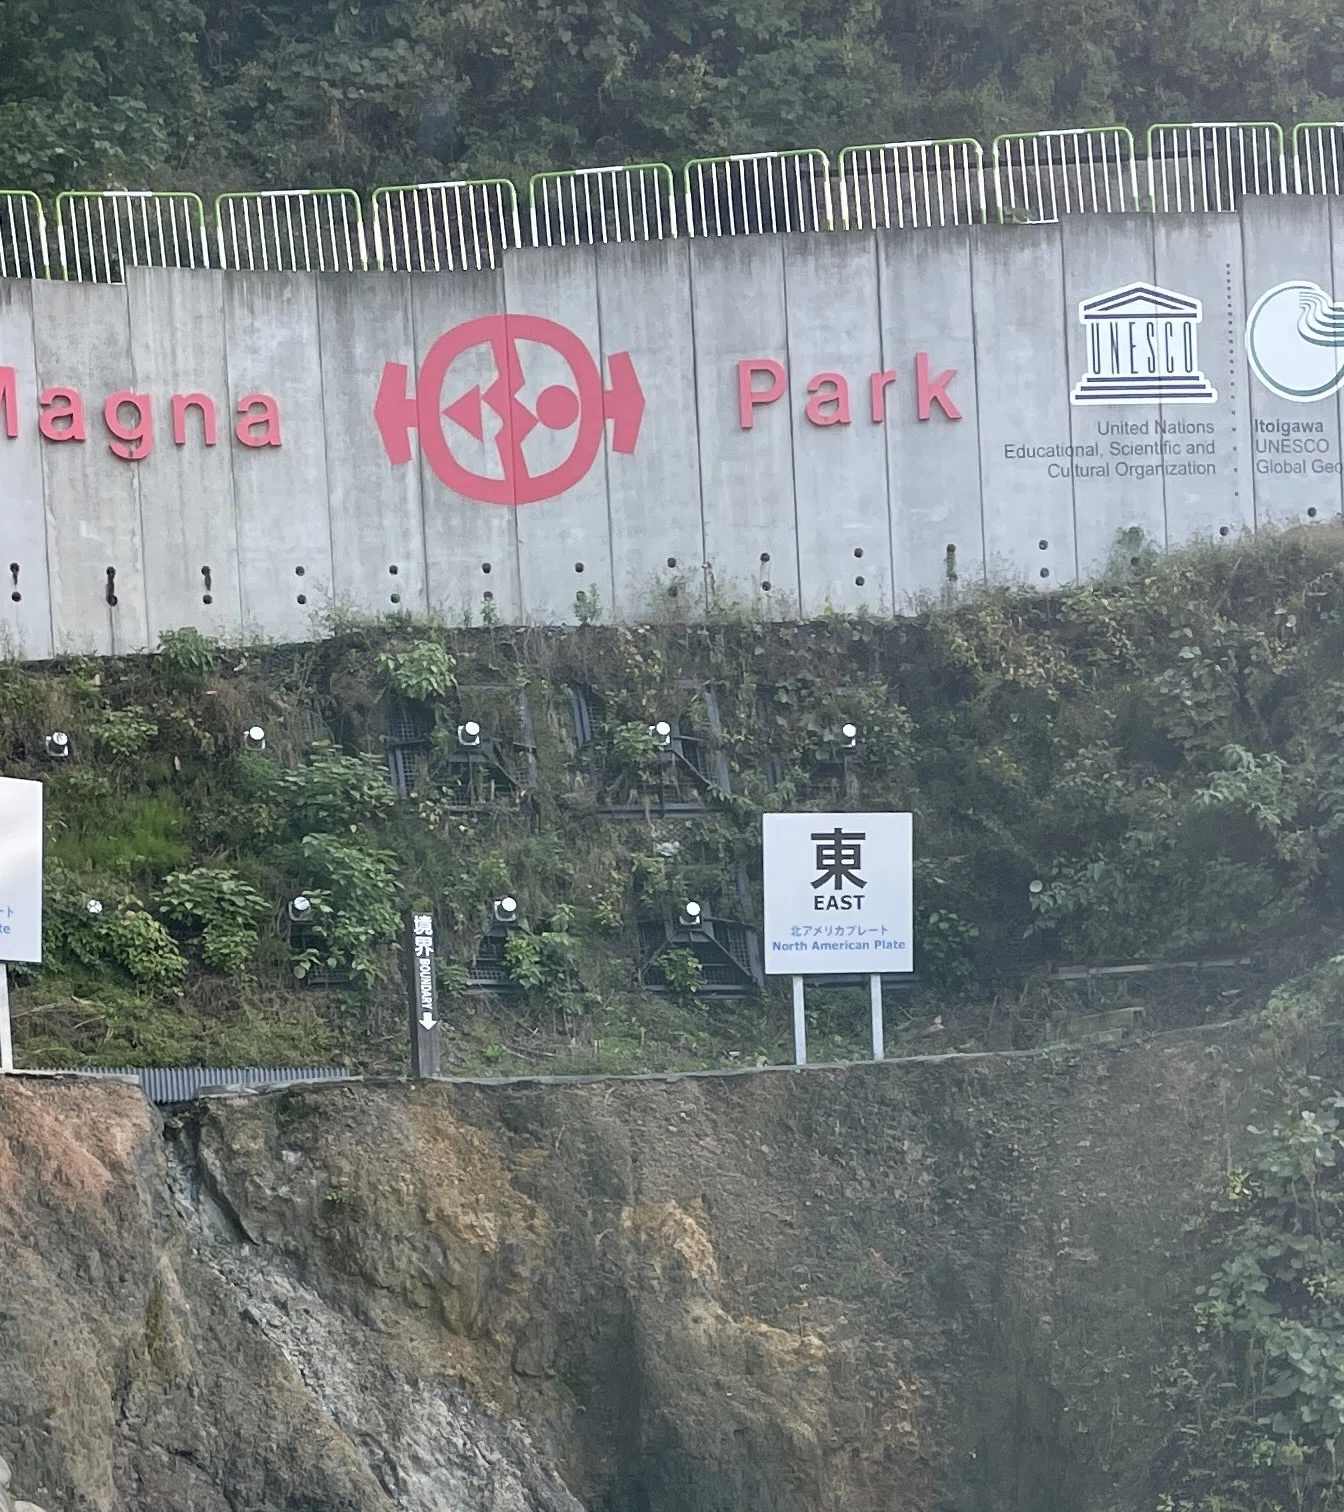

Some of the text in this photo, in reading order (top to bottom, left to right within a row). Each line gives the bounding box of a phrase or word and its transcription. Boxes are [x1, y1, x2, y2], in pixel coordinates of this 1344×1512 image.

[1090, 321, 1194, 375] UNESCO
[737, 351, 963, 429] Park
[1097, 419, 1215, 436] United Nations
[1004, 440, 1216, 459] Educational, Scientific and
[1255, 438, 1330, 453] UNESCO
[1047, 461, 1216, 478] Cultural Organization
[1256, 459, 1307, 474] Global
[810, 827, 868, 890] 東
[814, 895, 865, 910] EAST
[413, 915, 434, 957] 境界
[791, 925, 888, 936] 北アメリカプレート
[772, 940, 906, 951] North American Plate
[419, 958, 433, 1010] BOUNDARY
